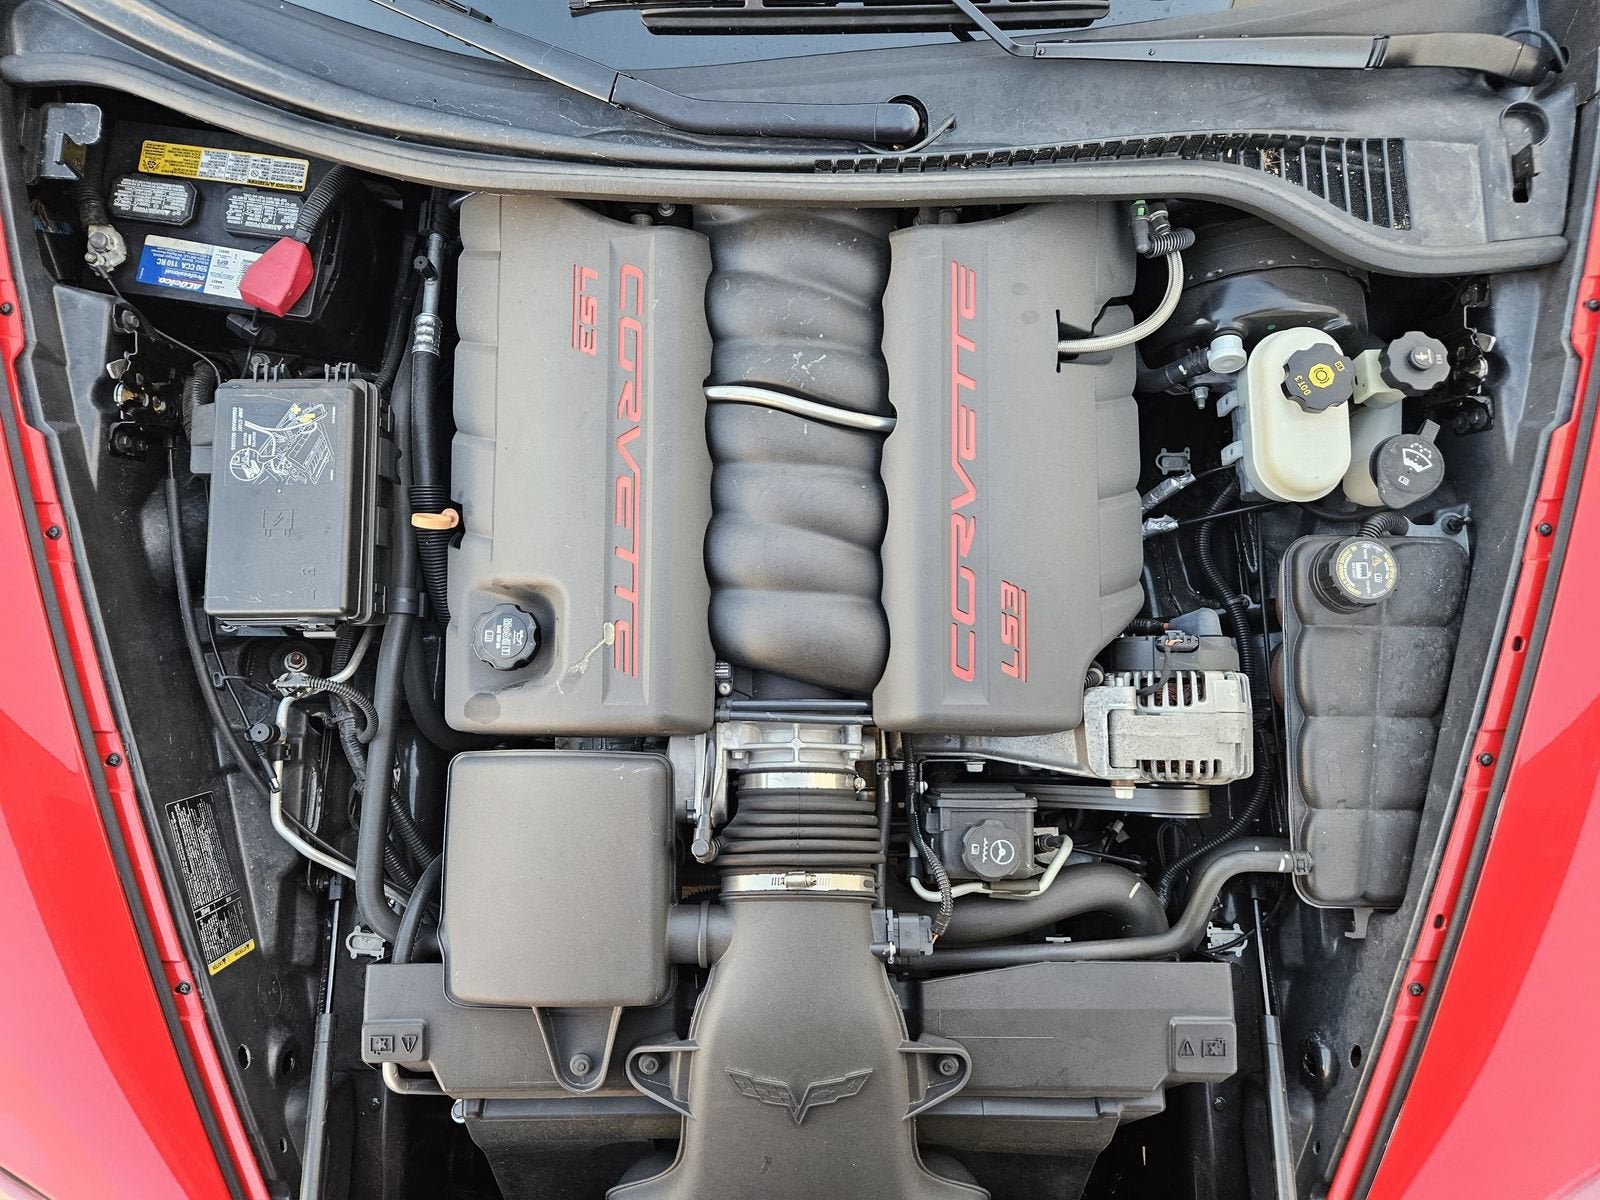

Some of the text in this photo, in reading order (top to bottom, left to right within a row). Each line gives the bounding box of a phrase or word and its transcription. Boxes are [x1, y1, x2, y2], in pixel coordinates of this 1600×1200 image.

[156, 258, 167, 266] RC
[167, 259, 178, 267] 110
[181, 262, 196, 270] CCA
[164, 268, 205, 281] Professional
[158, 277, 203, 290] ACDelco
[579, 264, 598, 356] LS3
[1297, 381, 1312, 396] DOT
[614, 263, 644, 679] CORVETTE
[951, 261, 976, 683] CORVETTE
[1001, 579, 1019, 679] LS3
